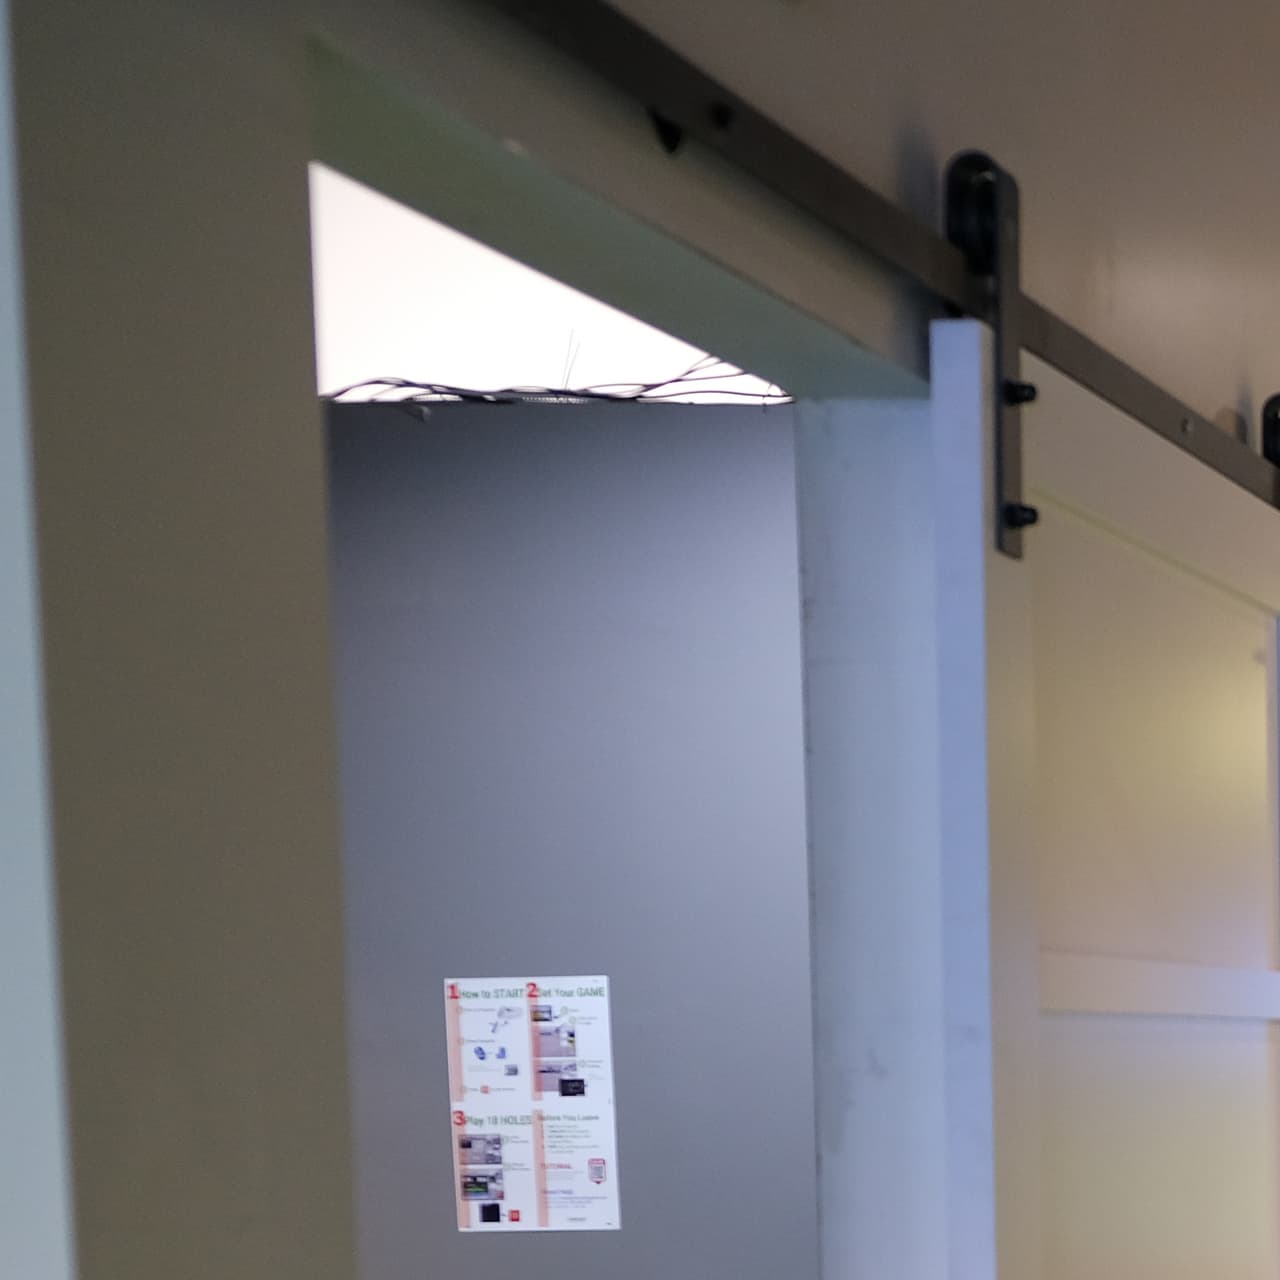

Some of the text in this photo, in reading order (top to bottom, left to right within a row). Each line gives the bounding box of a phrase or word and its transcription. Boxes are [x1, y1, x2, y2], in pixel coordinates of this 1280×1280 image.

[448, 983, 460, 999] 1
[527, 982, 538, 998] 2
[576, 986, 605, 997] GAME
[453, 1110, 466, 1126] 3
